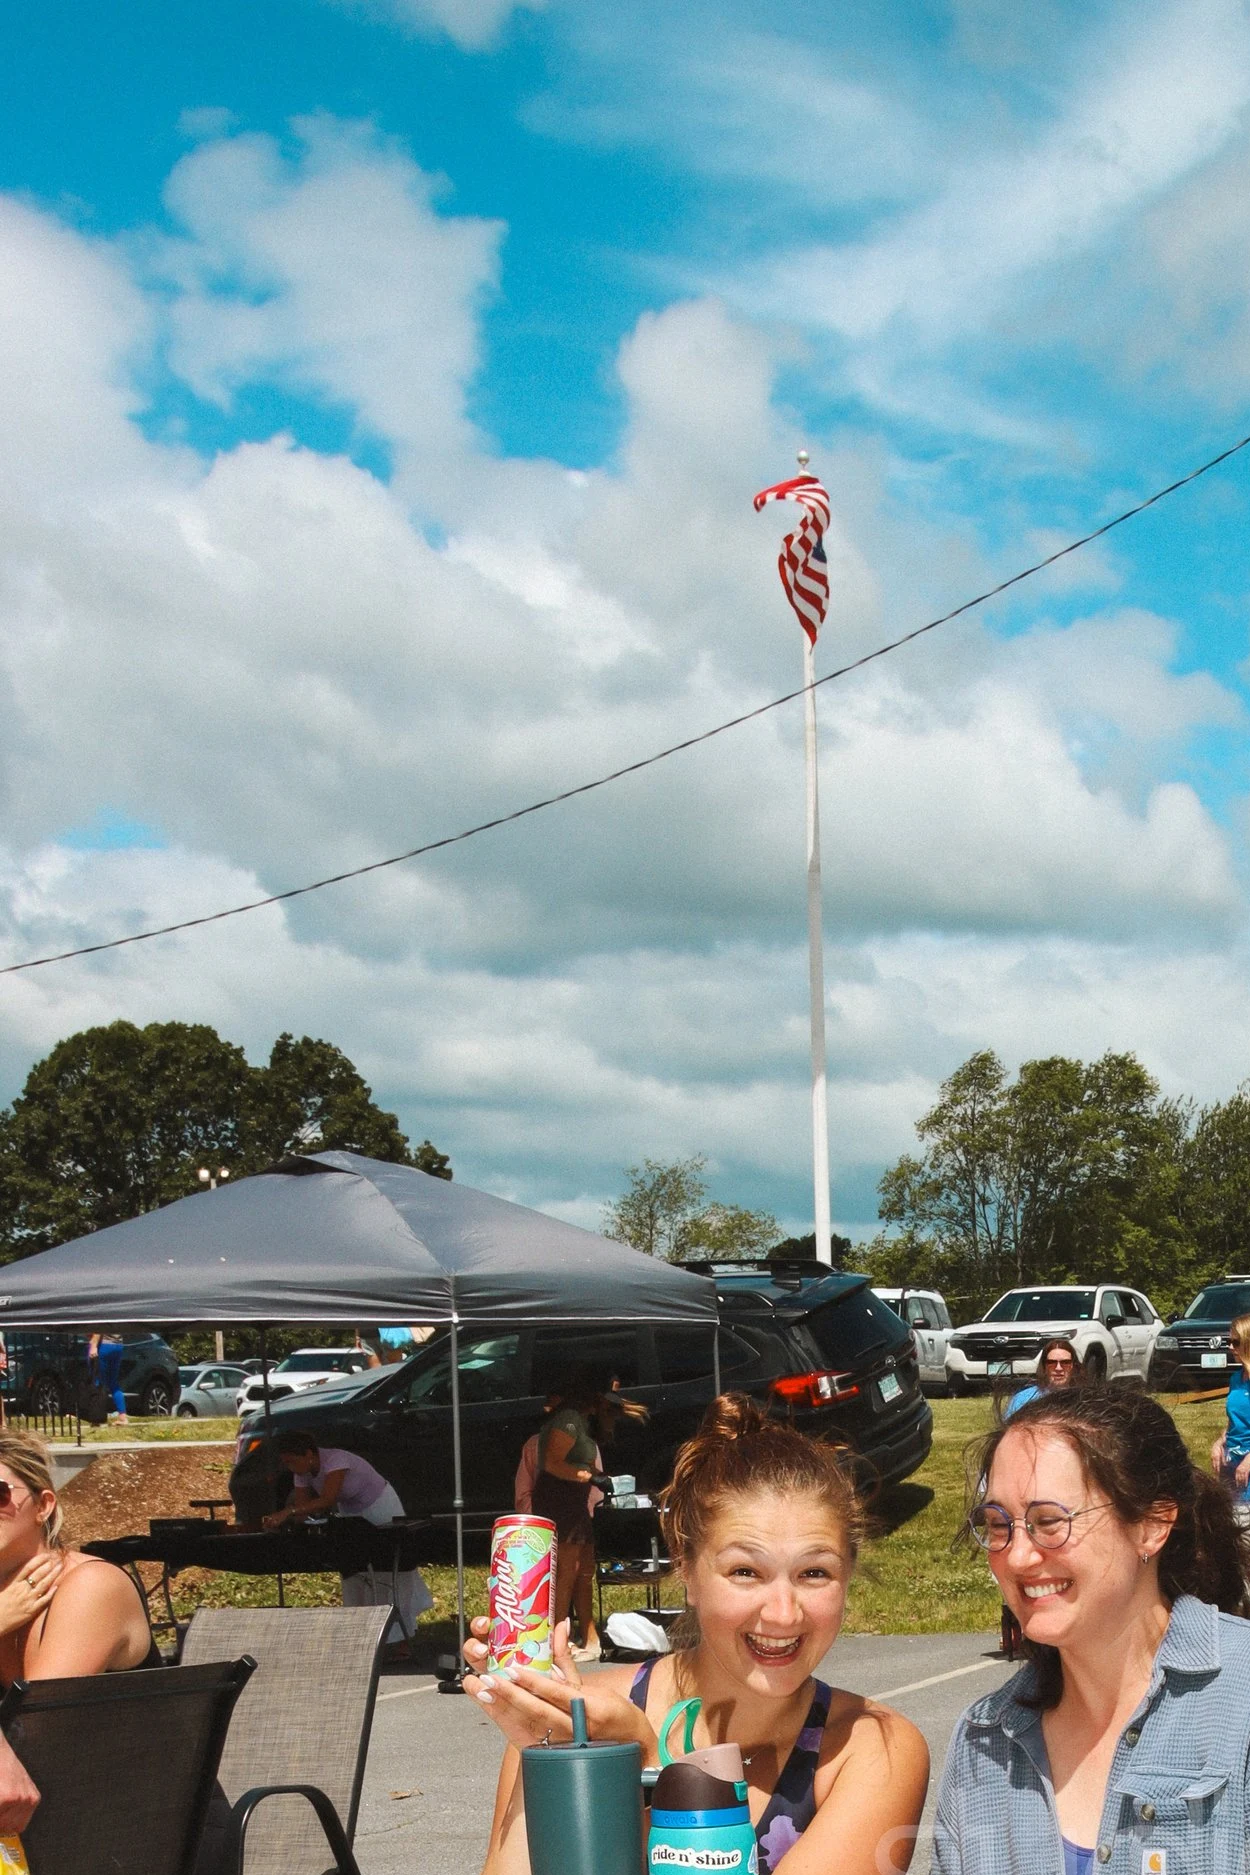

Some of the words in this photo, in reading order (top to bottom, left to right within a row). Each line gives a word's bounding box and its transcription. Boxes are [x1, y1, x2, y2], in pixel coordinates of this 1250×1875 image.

[494, 1557, 527, 1632] Alani
[652, 1848, 676, 1861] ride
[695, 1853, 739, 1866] shine
